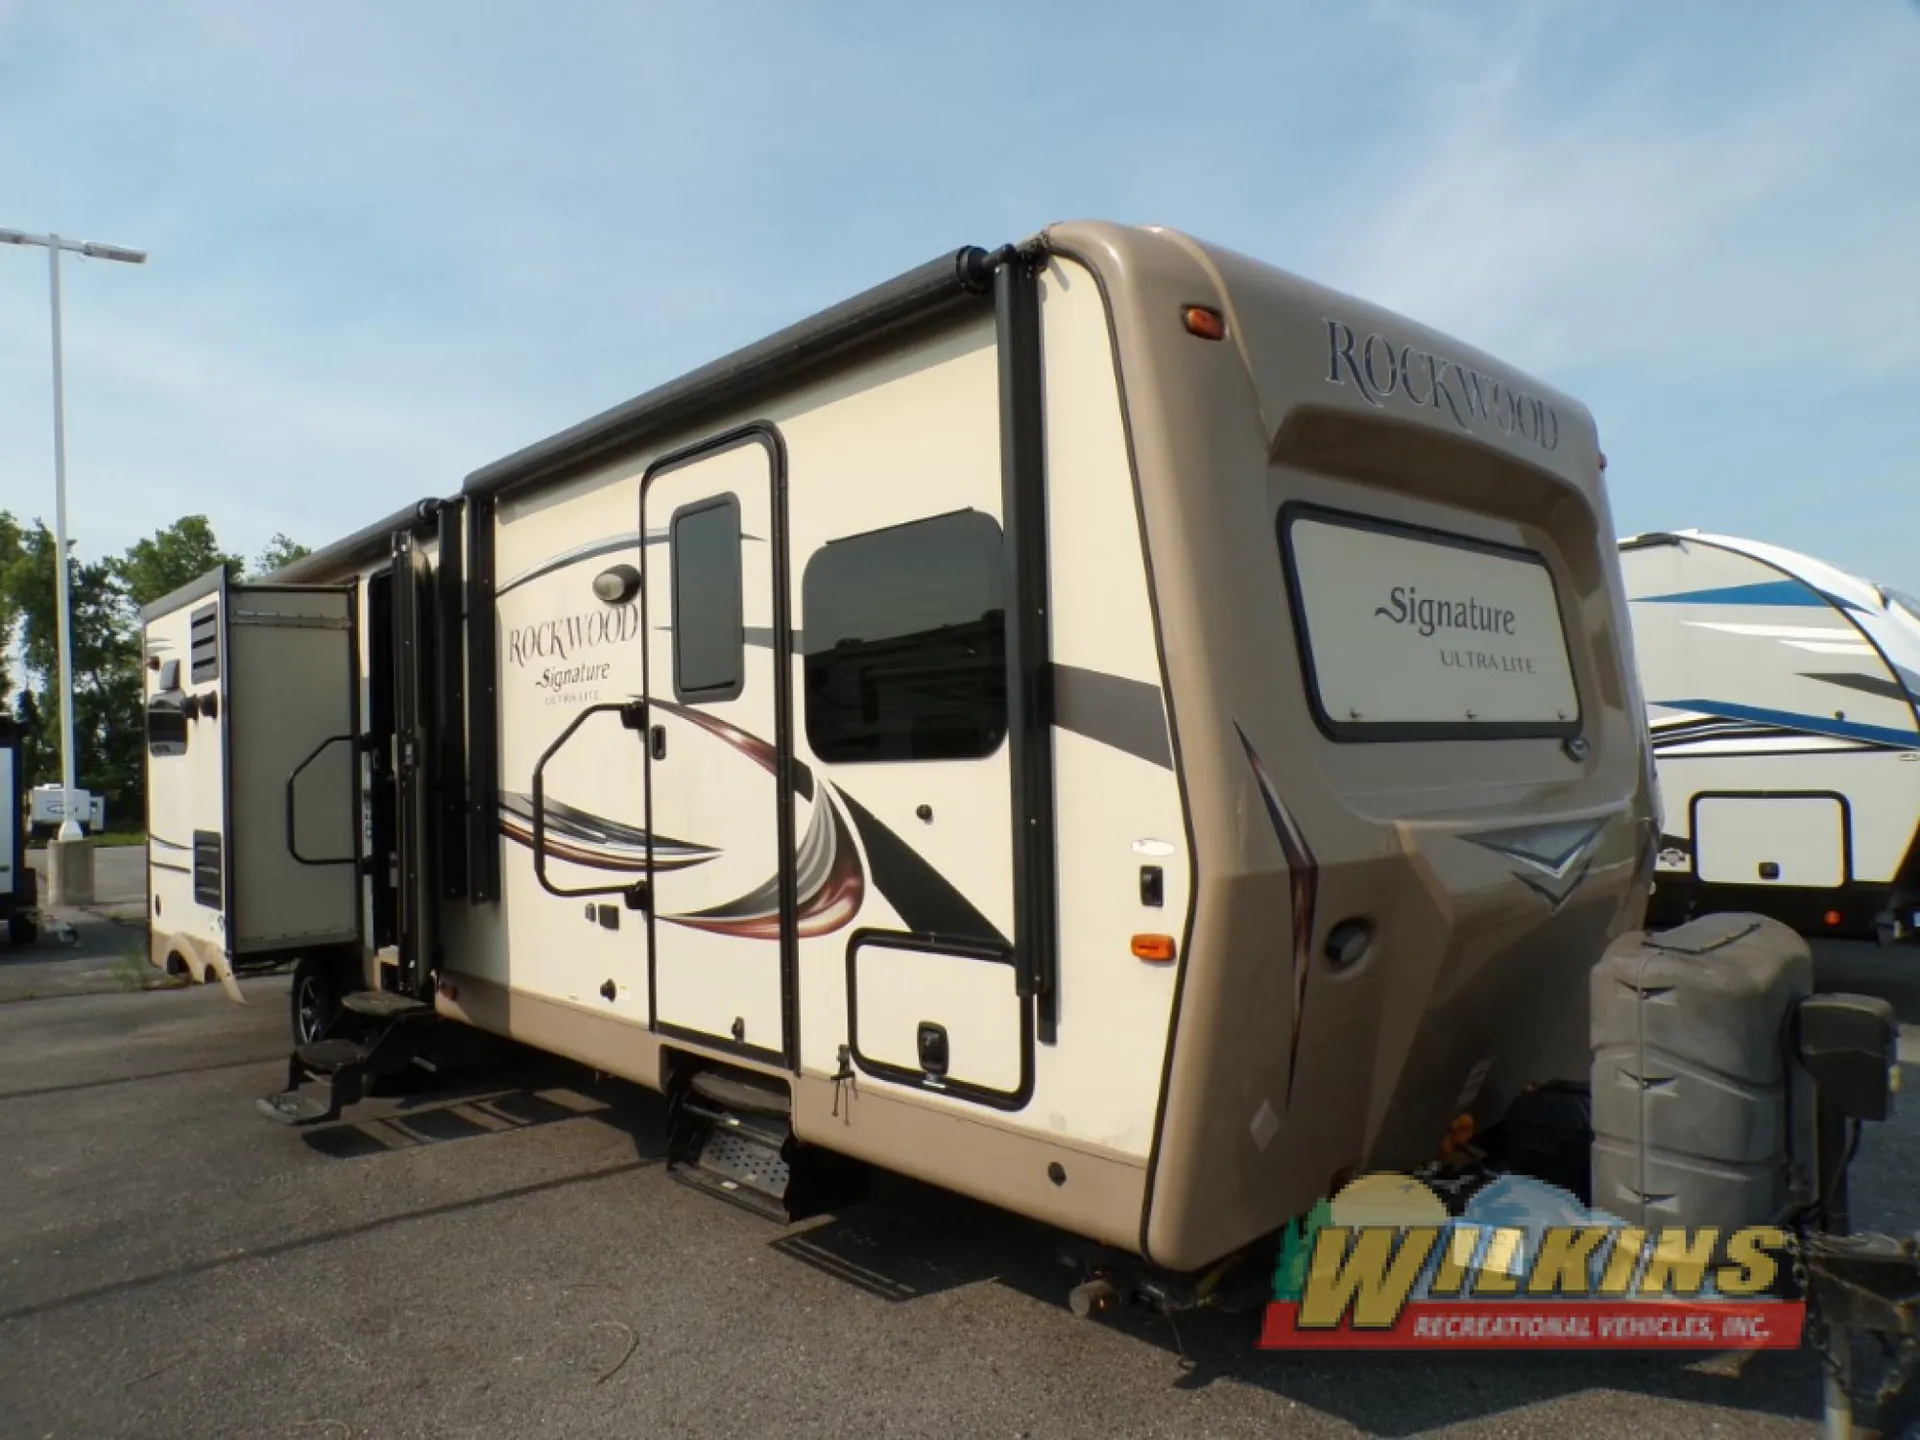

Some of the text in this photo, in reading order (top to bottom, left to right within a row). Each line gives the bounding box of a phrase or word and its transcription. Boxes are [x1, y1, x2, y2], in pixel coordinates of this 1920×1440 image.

[1323, 317, 1558, 450] ROCKWOOD
[509, 603, 638, 668] ROCKWOOD
[1375, 586, 1515, 637] Signature
[535, 662, 610, 692] Signature
